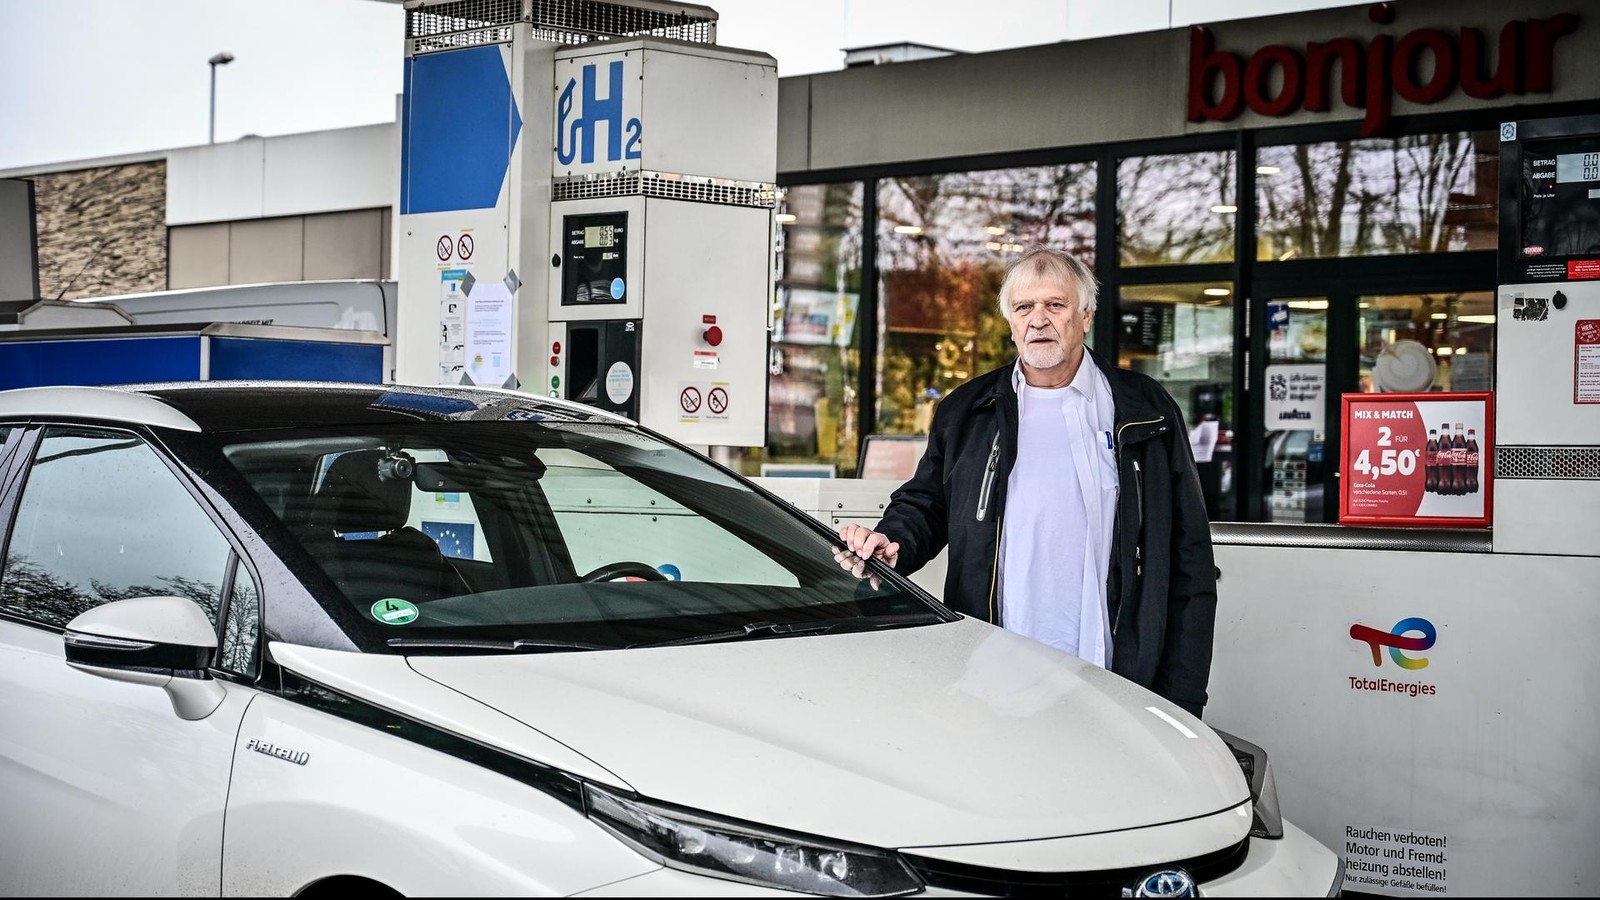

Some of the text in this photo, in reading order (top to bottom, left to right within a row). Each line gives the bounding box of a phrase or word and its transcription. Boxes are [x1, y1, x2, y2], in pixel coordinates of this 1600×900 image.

[1187, 2, 1580, 137] bonjour
[1533, 159, 1556, 167] BETRAG
[1354, 410, 1413, 419] MIX & MATCH
[1377, 426, 1408, 446] 2 FÜR
[385, 600, 399, 612] 4
[1348, 676, 1436, 697] TotalEnergies
[1346, 825, 1447, 848] Rauchen verboten!
[1346, 841, 1447, 864] Motor und Fremd-
[1345, 857, 1446, 881] heizung abstellen!
[1345, 874, 1447, 893] Nur zulässige Gefäße befüllen!
